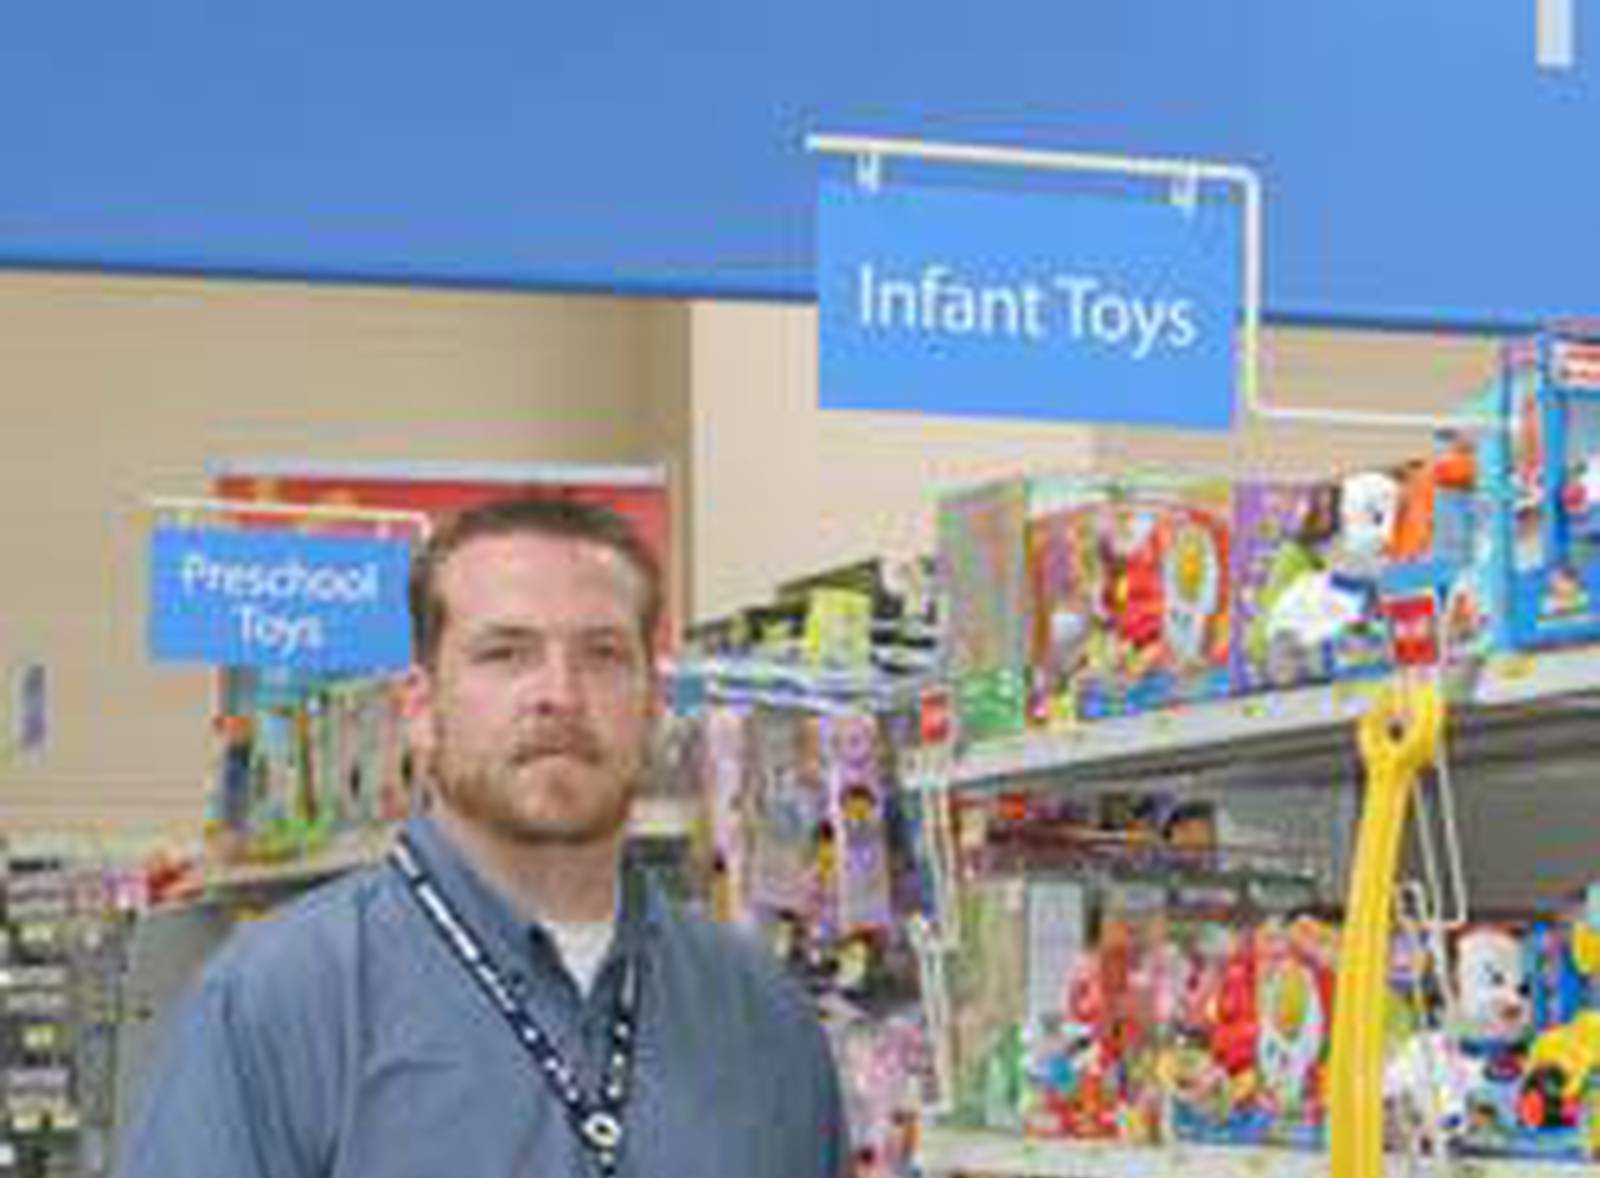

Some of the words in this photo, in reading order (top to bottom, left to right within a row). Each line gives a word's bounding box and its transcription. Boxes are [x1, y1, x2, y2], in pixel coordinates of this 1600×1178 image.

[858, 262, 1043, 338] Infant
[1054, 273, 1198, 360] Toys
[181, 551, 379, 602] Preschool
[233, 604, 324, 659] Toys
